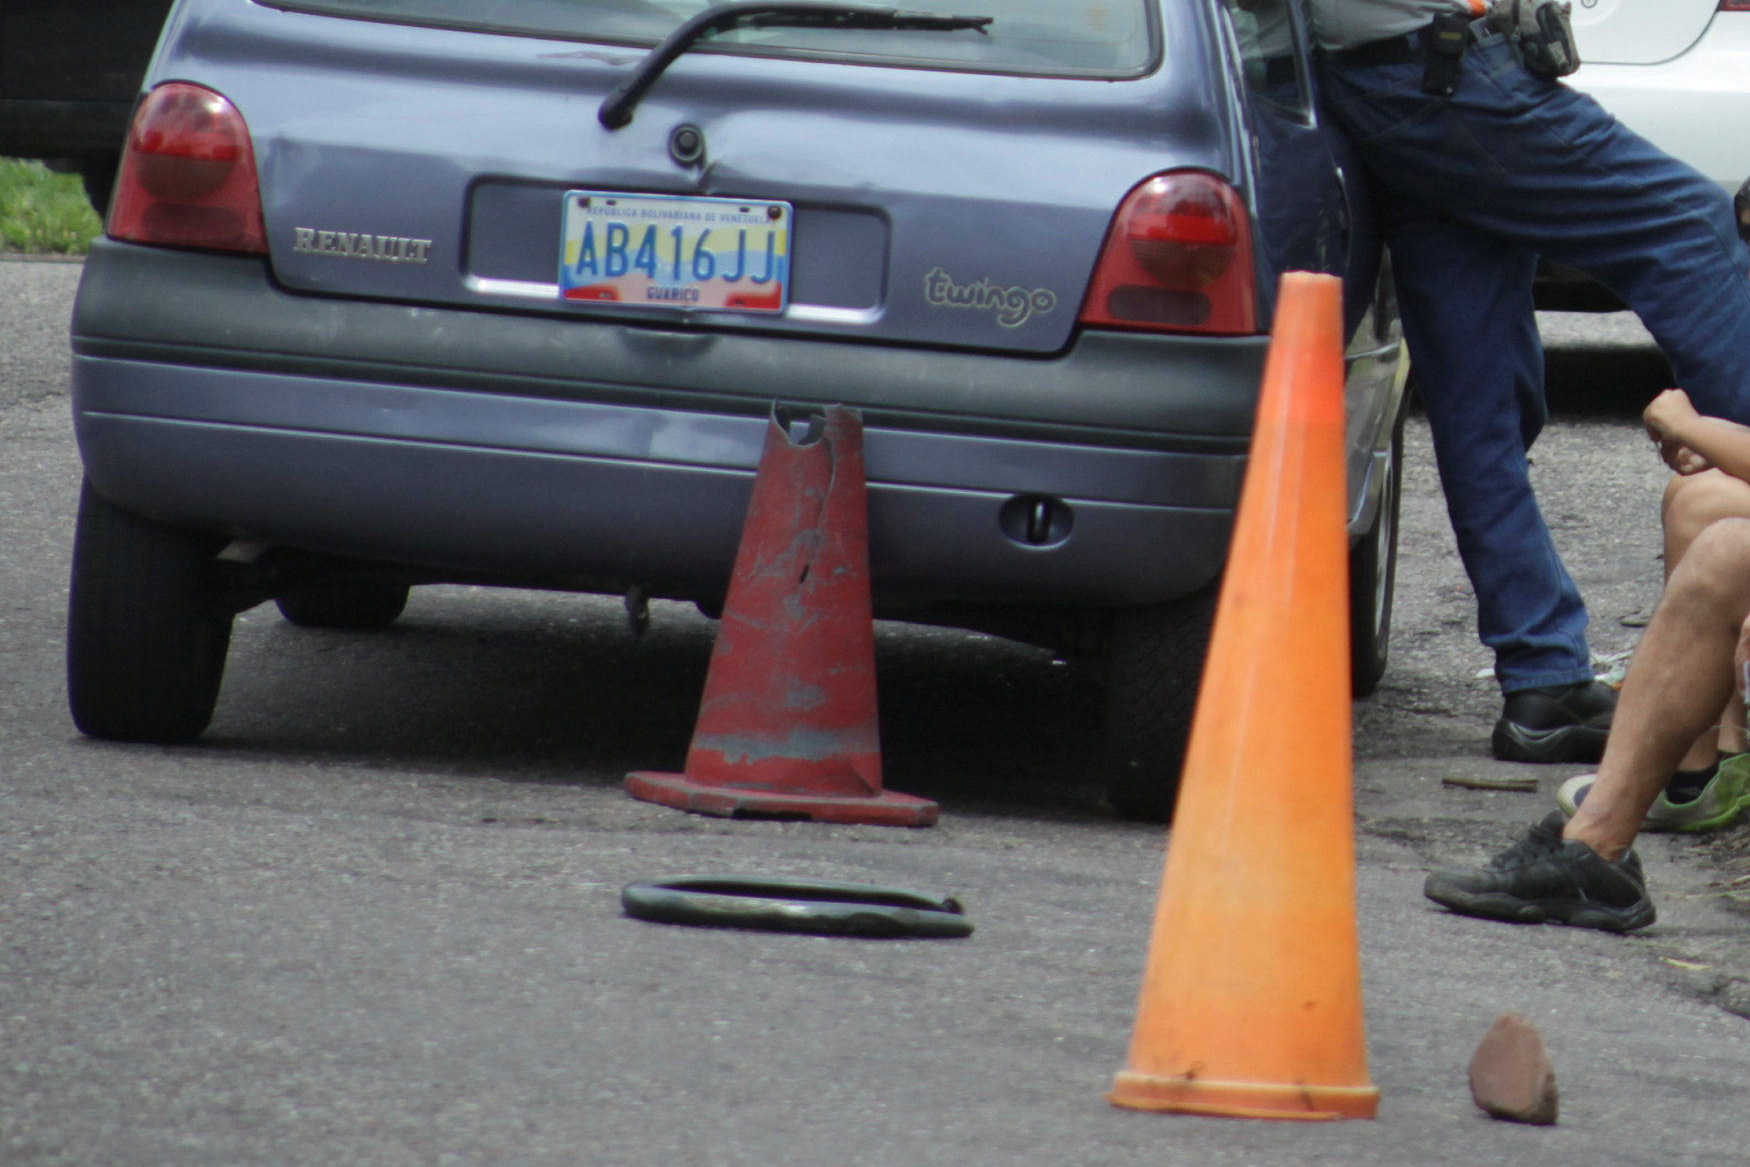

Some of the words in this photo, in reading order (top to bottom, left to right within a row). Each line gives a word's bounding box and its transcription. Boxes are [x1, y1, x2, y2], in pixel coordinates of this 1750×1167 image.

[640, 209, 702, 221] BOLIVARIANA
[704, 212, 716, 222] DE
[293, 227, 432, 263] RENAULT
[575, 219, 775, 284] AB416JJ
[925, 265, 1057, 327] twingo
